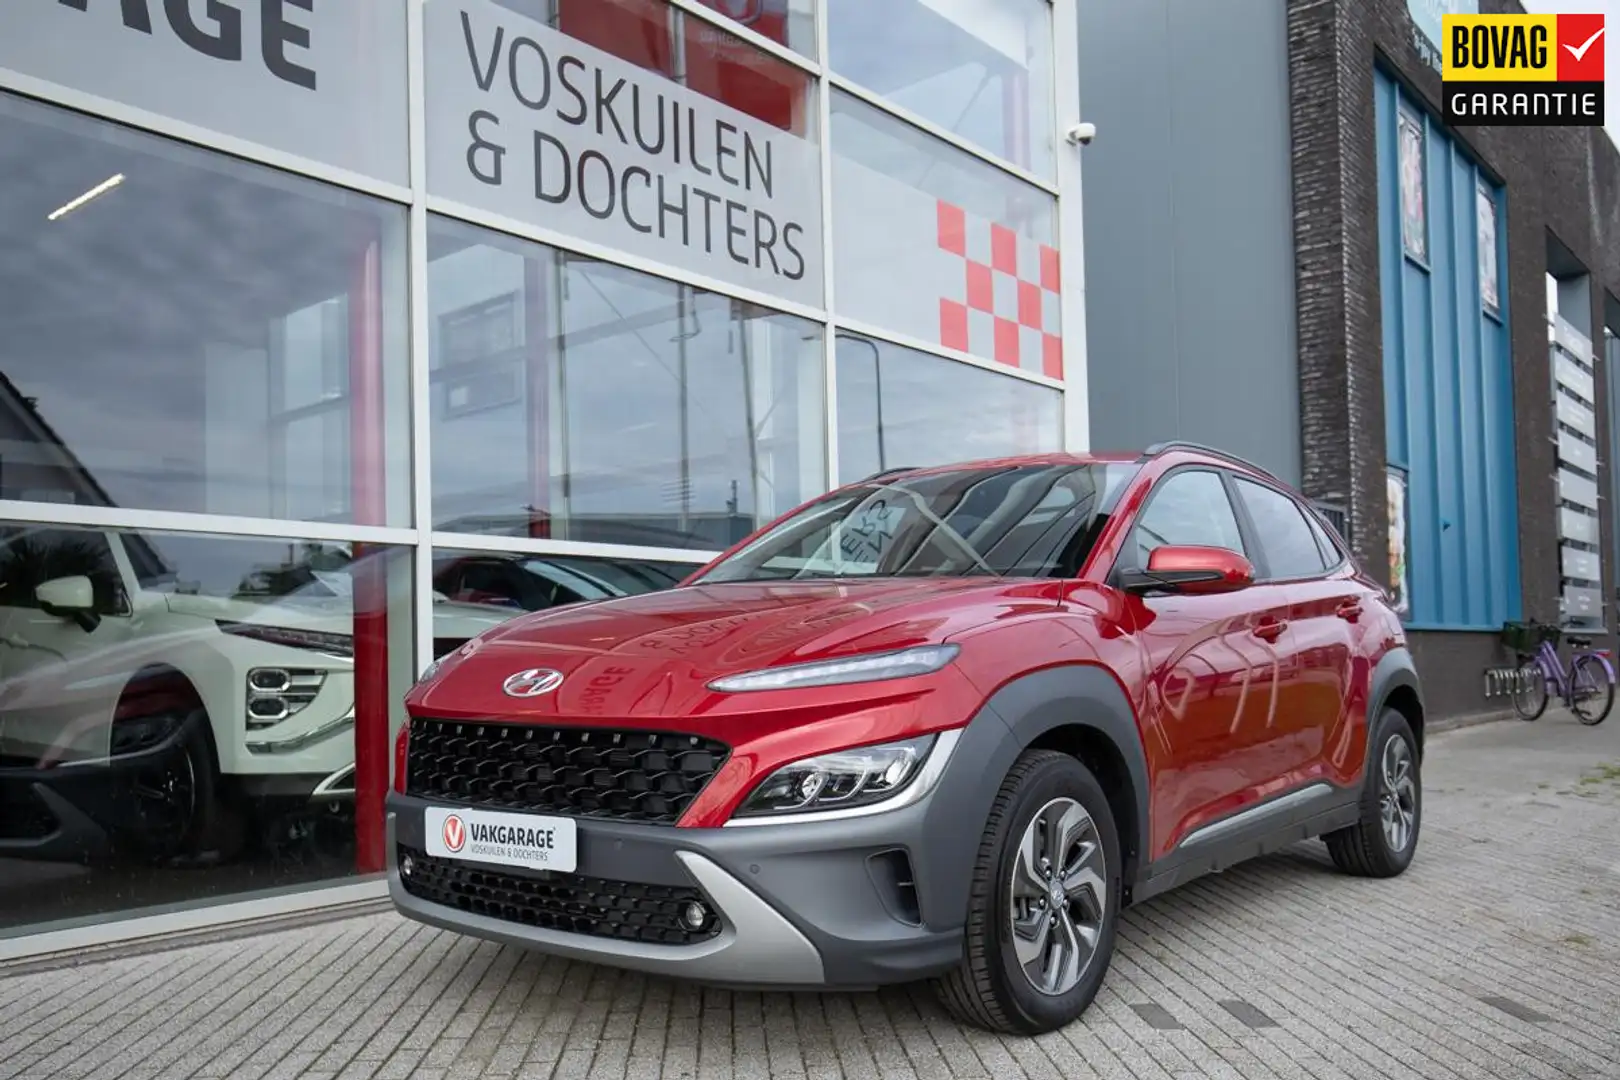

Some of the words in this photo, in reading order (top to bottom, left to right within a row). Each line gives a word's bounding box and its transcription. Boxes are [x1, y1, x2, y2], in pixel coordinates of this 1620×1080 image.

[460, 10, 773, 199] VOSKUILEN
[466, 110, 506, 187] &
[533, 129, 806, 281] DOCHTERS
[470, 823, 554, 849] VAKGARAGE
[470, 844, 506, 857] VOSKUILEN
[507, 849, 513, 858] &
[513, 849, 548, 861] DOCHTERS
